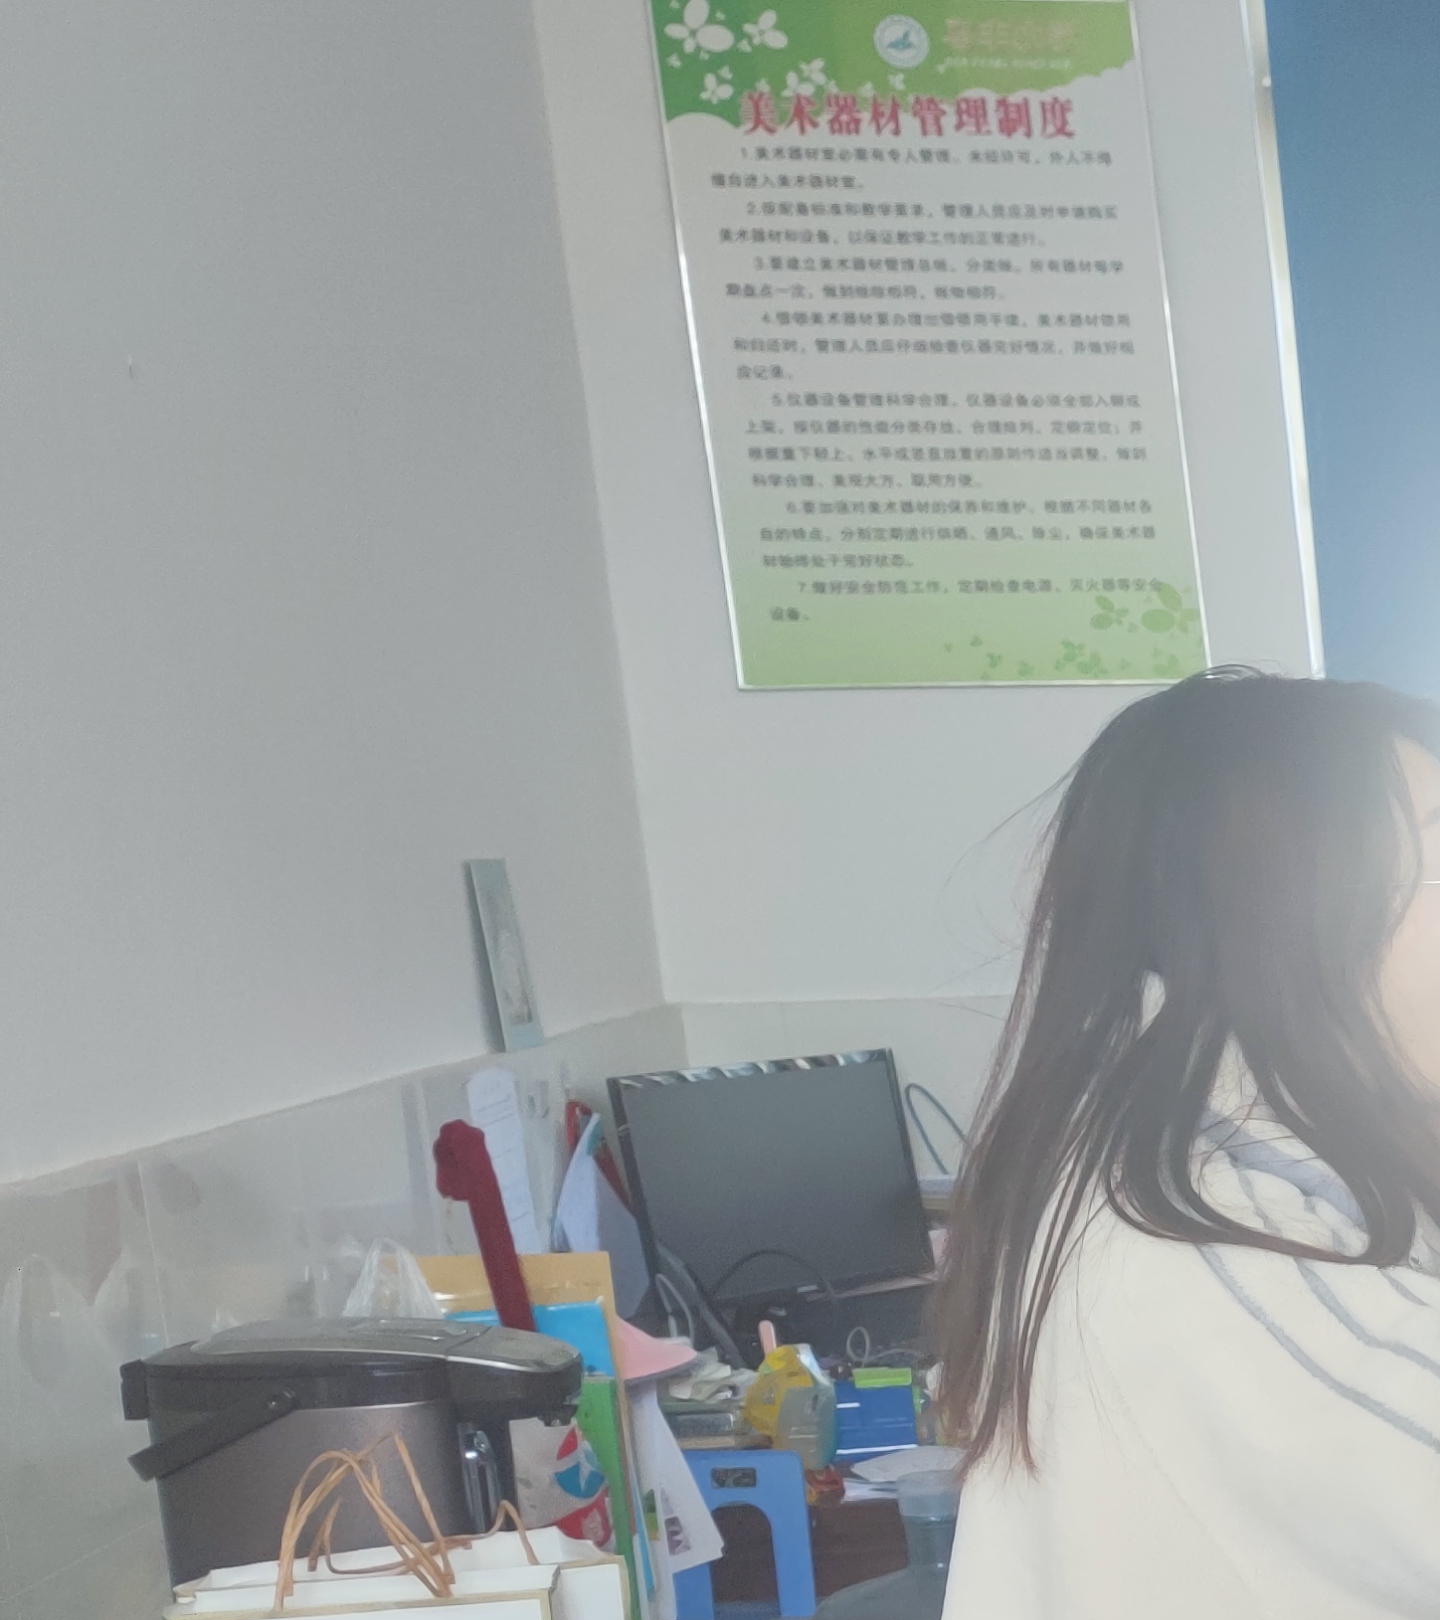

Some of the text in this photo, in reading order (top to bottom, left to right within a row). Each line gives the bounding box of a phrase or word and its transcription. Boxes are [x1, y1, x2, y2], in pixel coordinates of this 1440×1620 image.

[743, 94, 1075, 139] 美术器材管理制度
